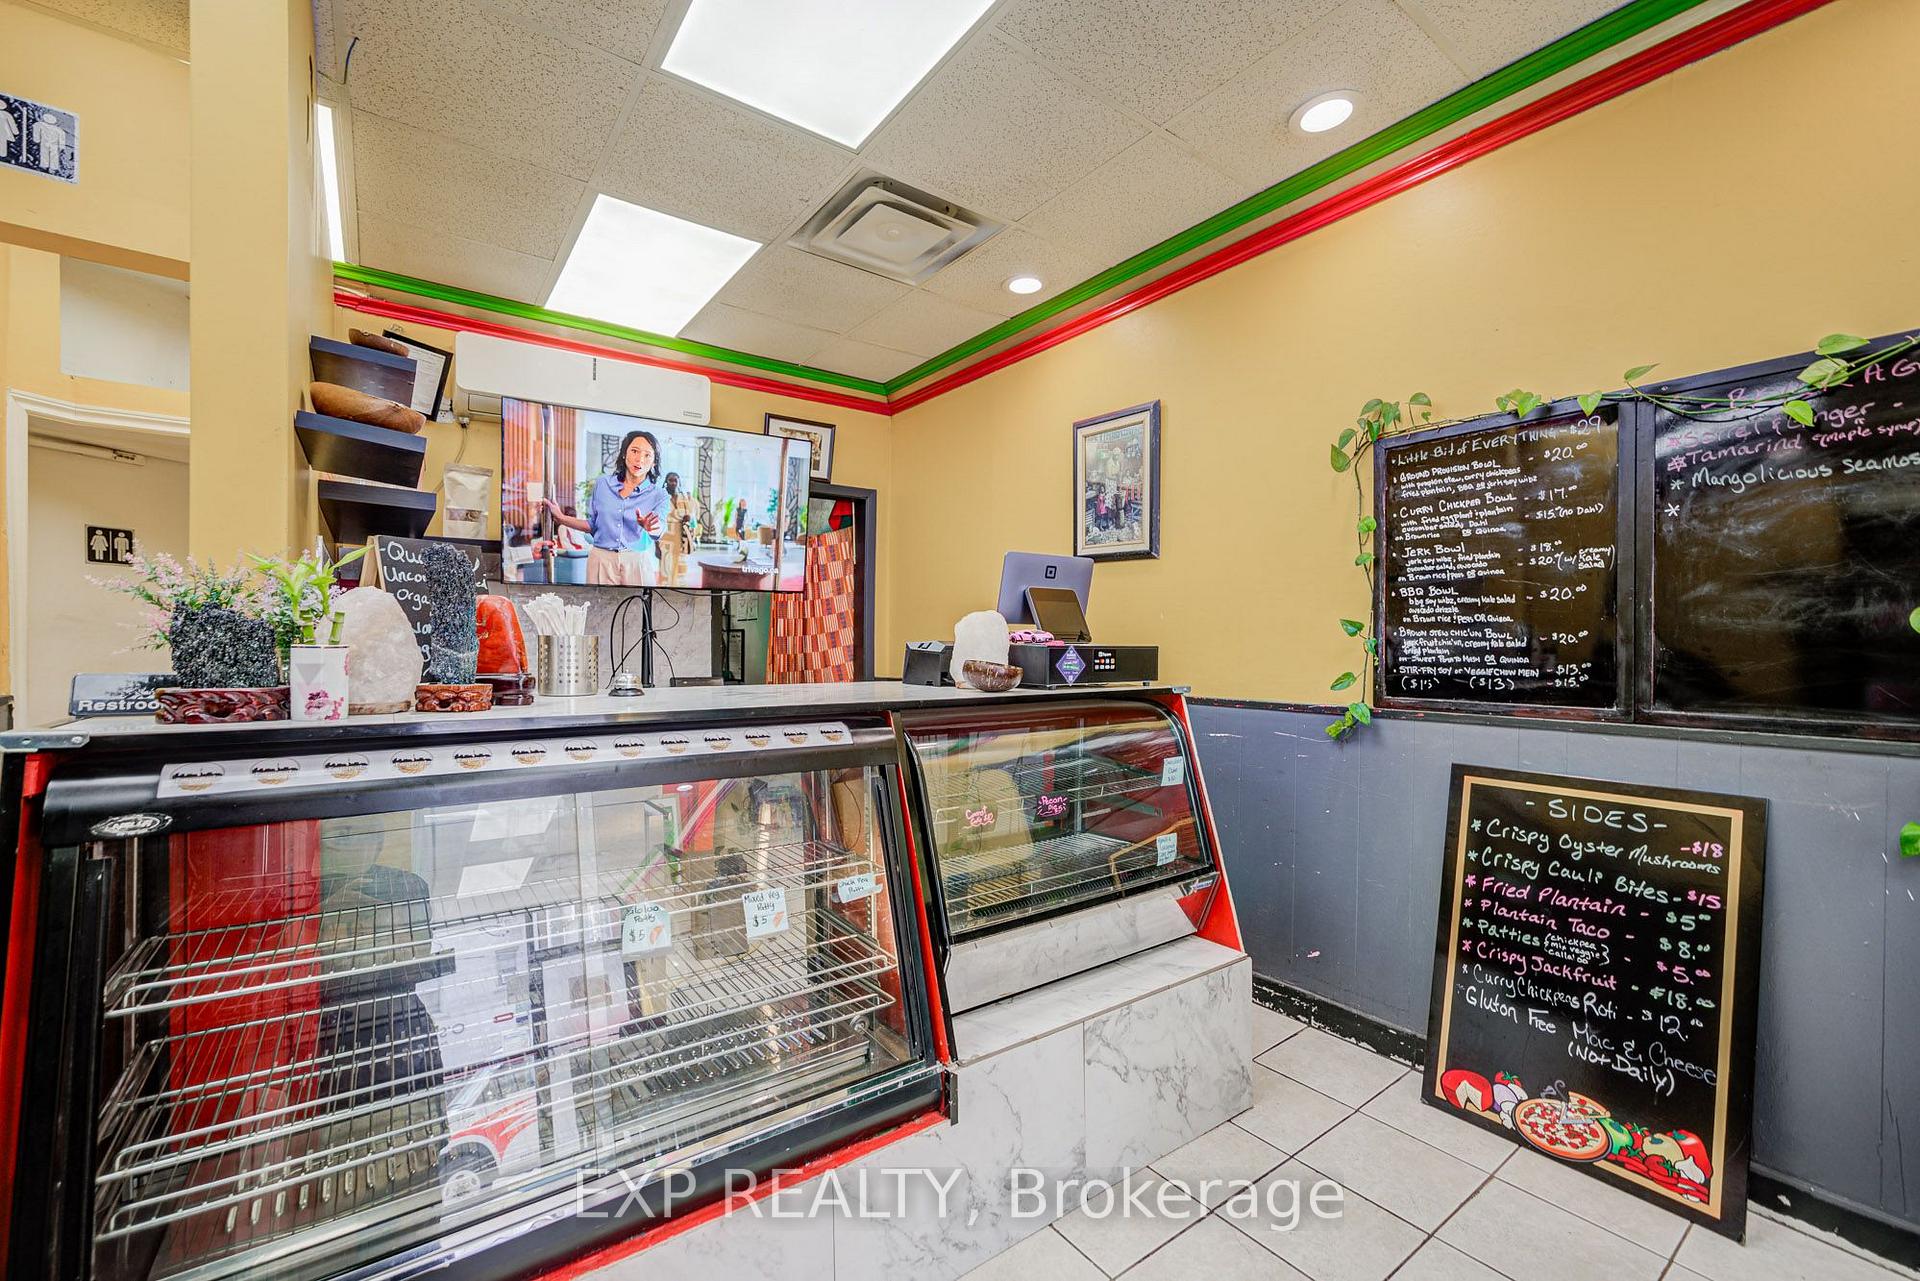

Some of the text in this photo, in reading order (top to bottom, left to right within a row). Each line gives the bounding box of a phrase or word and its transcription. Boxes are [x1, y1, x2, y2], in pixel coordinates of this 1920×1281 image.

[1398, 450, 1429, 466] Little
[1434, 442, 1455, 457] Bit
[1457, 440, 1470, 455] of
[1686, 435, 1802, 465] Tamarind
[1400, 587, 1424, 597] BBQ
[78, 700, 164, 712] Restroo
[1548, 799, 1649, 833] SIDES
[1486, 818, 1722, 875] Crispy Oyster Mushrooms
[1481, 847, 1540, 880] Crispy
[1548, 860, 1603, 885] Cauli
[1615, 876, 1670, 905] Bites
[1481, 877, 1627, 918] Fried Plantain
[1478, 919, 1541, 947] Patties
[1481, 900, 1558, 931] Plantain
[1568, 917, 1611, 940] Taco
[1477, 942, 1528, 975] Crispy
[1531, 954, 1618, 991] Jackfruit
[1473, 964, 1516, 998] Curry
[1583, 992, 1618, 1020] Roti
[1527, 1008, 1557, 1034] Free
[1572, 1020, 1615, 1051] Mac
[1648, 1041, 1718, 1086] Cheese
